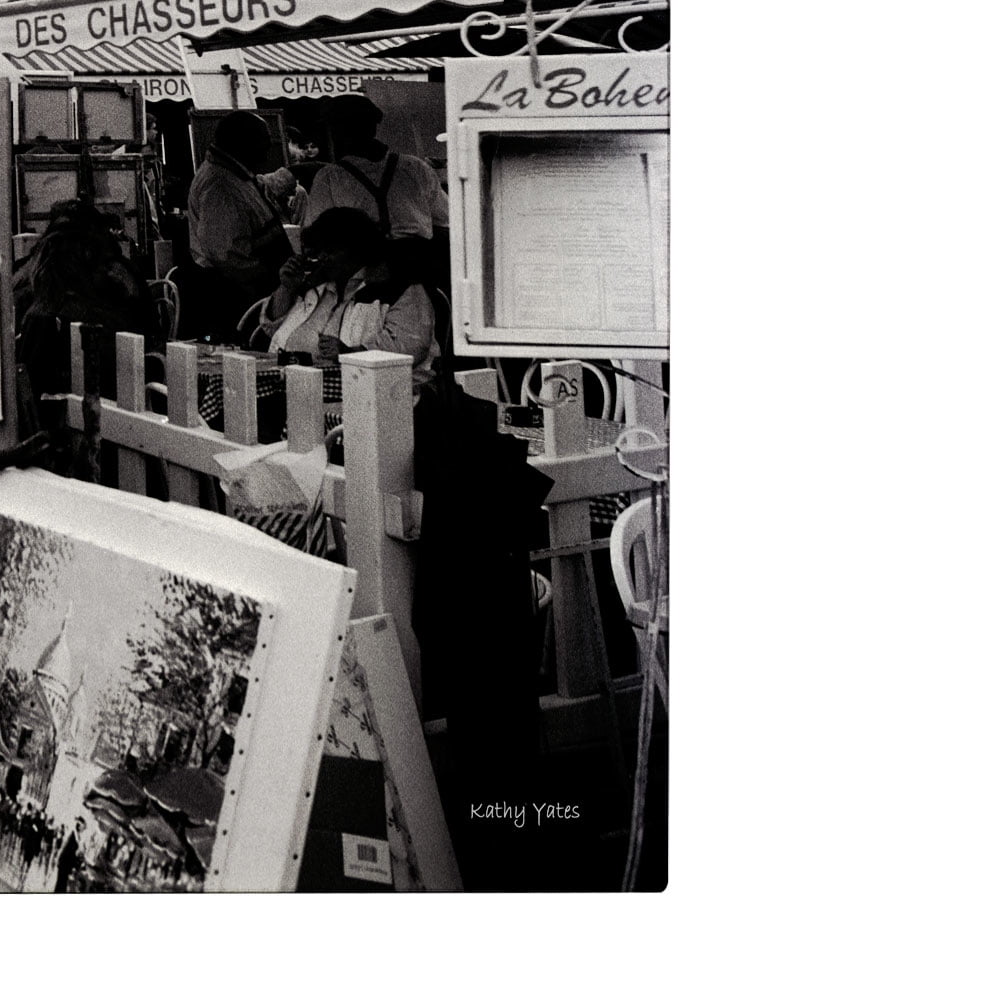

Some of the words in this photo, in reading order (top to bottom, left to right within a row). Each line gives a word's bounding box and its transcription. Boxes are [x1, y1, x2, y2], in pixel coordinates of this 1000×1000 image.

[16, 13, 67, 48] DES
[282, 76, 395, 94] CHASSE
[462, 69, 532, 111] La
